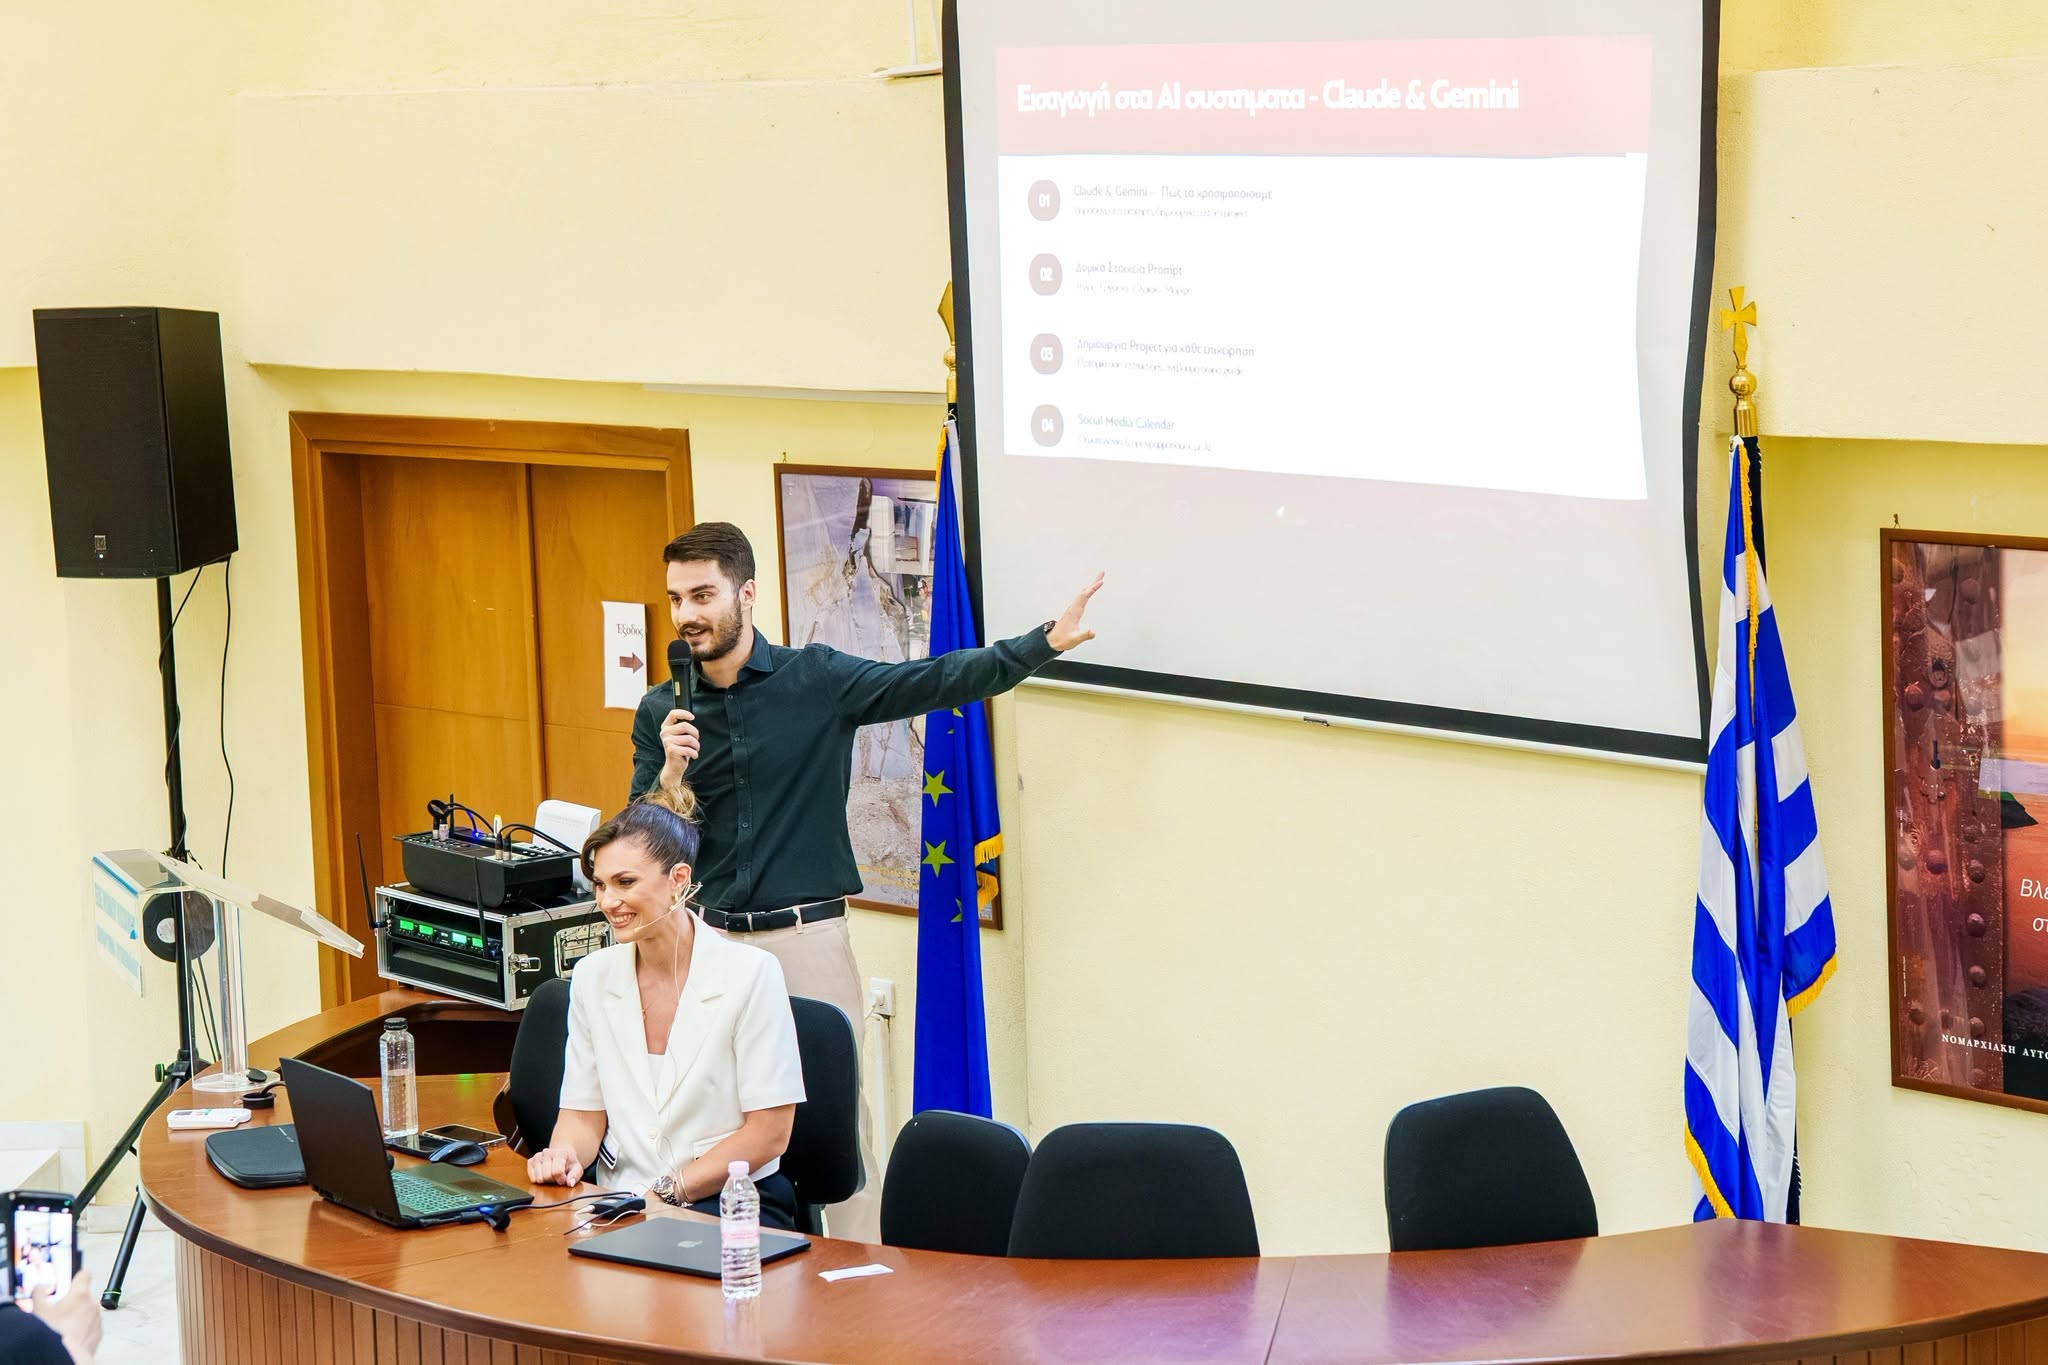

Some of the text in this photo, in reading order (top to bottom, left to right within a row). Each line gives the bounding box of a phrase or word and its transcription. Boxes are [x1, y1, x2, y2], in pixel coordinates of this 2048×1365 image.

[1017, 81, 1111, 118] Εισαγωγή
[1115, 89, 1153, 110] στα
[1157, 80, 1181, 110] AI
[1322, 79, 1401, 110] Claude
[1405, 79, 1426, 110] &
[1430, 78, 1519, 110] Gemini
[1073, 184, 1103, 197] Claude
[1106, 184, 1113, 197] &
[1115, 184, 1148, 197] Gemini
[1038, 193, 1050, 208] 01
[1039, 267, 1053, 281] 02
[1148, 263, 1182, 279] Prompt
[1040, 346, 1054, 361] 03
[1130, 339, 1162, 356] Project
[1164, 345, 1178, 357] για
[1041, 418, 1055, 433] 04
[1078, 414, 1176, 432] Social Media Calendar
[1941, 1034, 2016, 1054] ΝΟΜΑΡΧΙΑΚΗ
